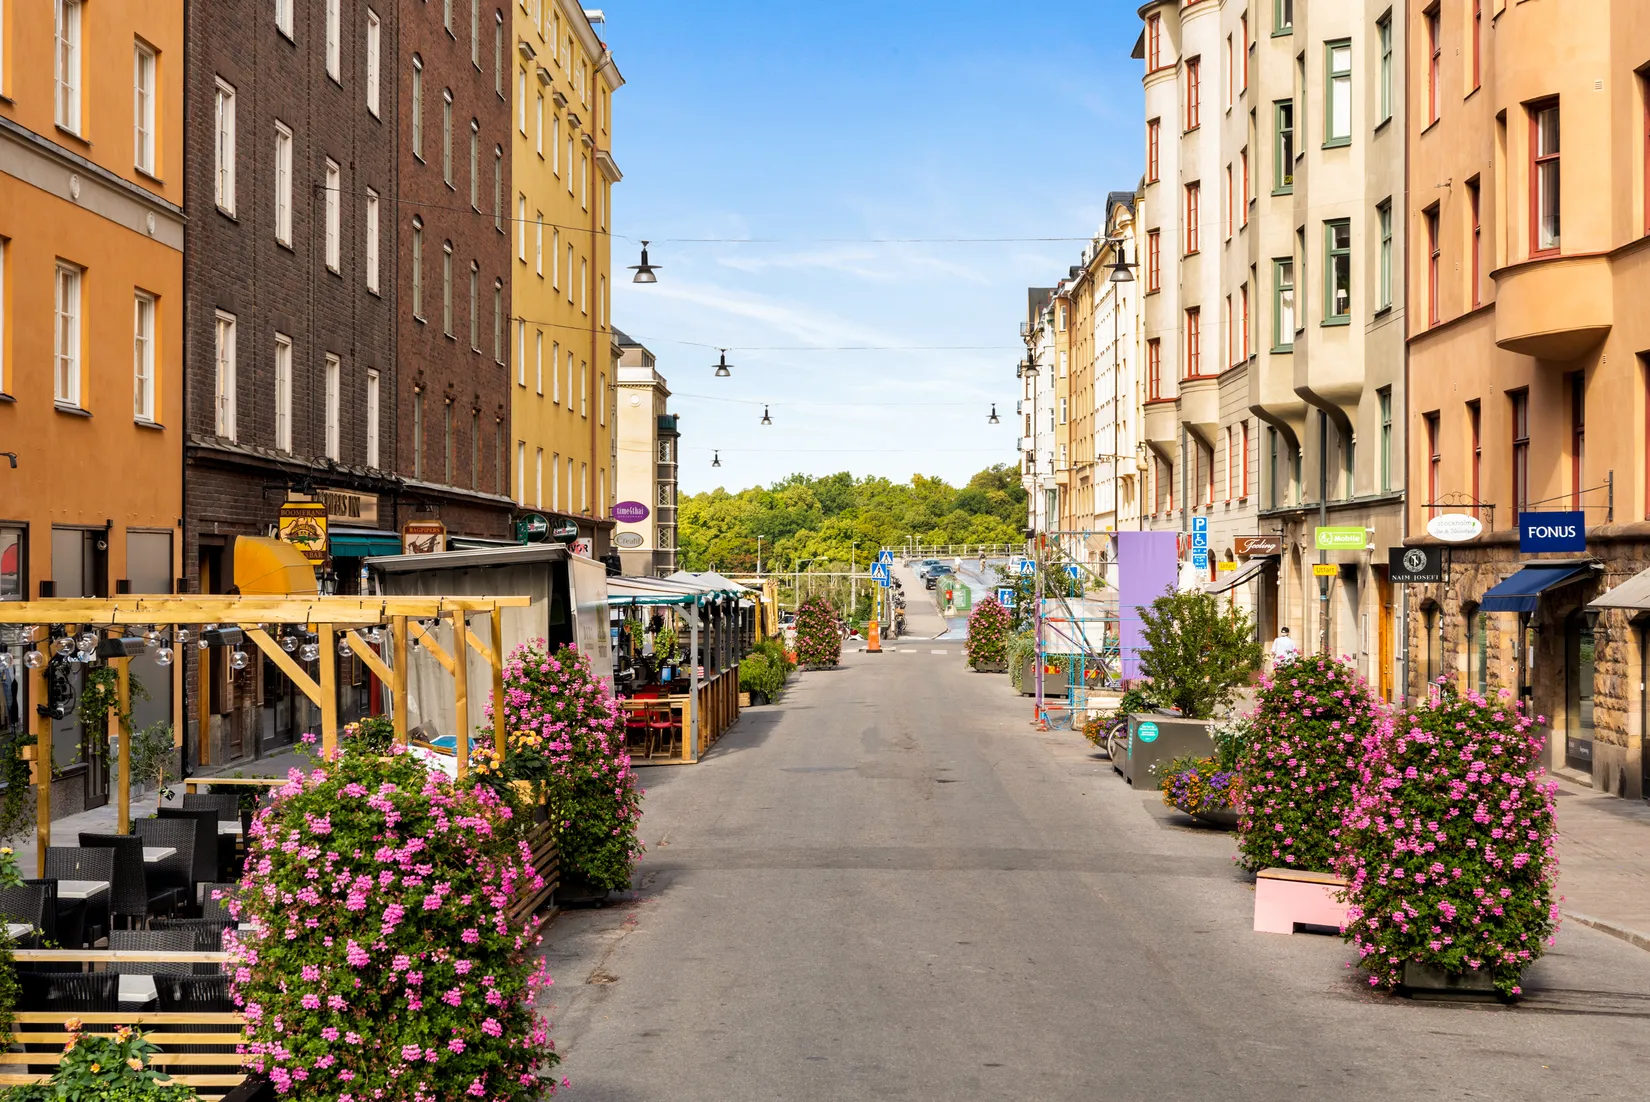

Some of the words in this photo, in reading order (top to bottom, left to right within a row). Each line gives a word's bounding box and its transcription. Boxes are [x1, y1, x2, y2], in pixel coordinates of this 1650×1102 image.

[280, 509, 326, 517] BOOMERANG
[1195, 518, 1205, 531] P
[1528, 525, 1576, 538] FONUS
[1239, 538, 1276, 553] Feeling
[1315, 565, 1335, 573] Utfart
[1413, 574, 1439, 582] JOSEFI
